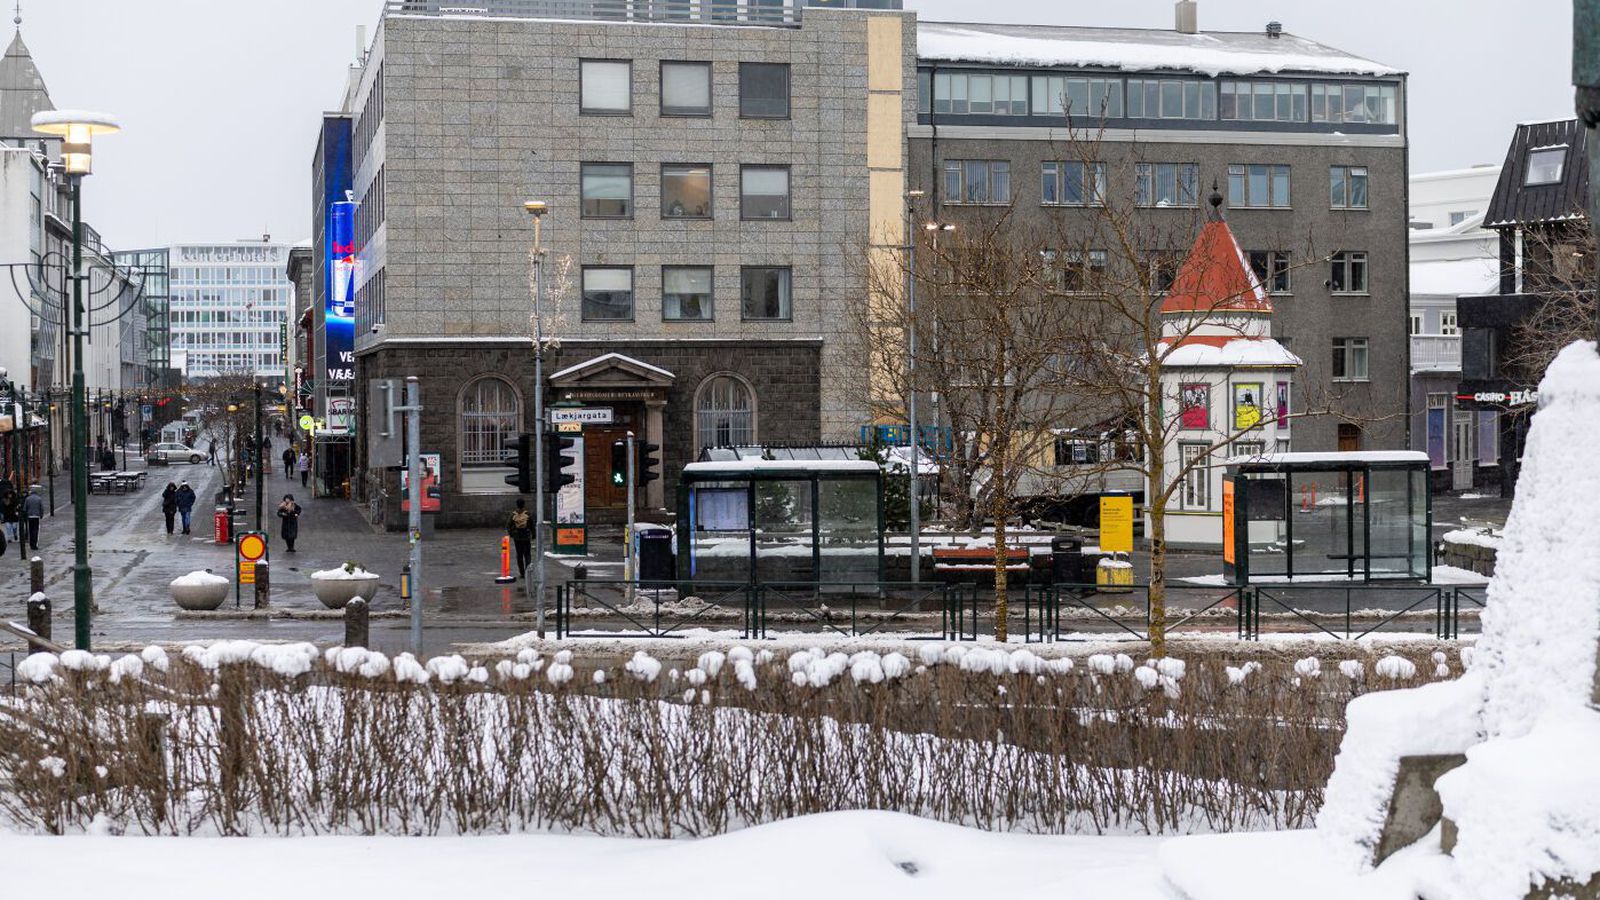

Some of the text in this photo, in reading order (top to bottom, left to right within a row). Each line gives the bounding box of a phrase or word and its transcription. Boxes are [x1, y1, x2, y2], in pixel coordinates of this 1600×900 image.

[339, 351, 355, 363] VE
[328, 368, 356, 380] VÆÆ
[1474, 392, 1505, 402] CASINO
[555, 412, 607, 421] Lækjargata
